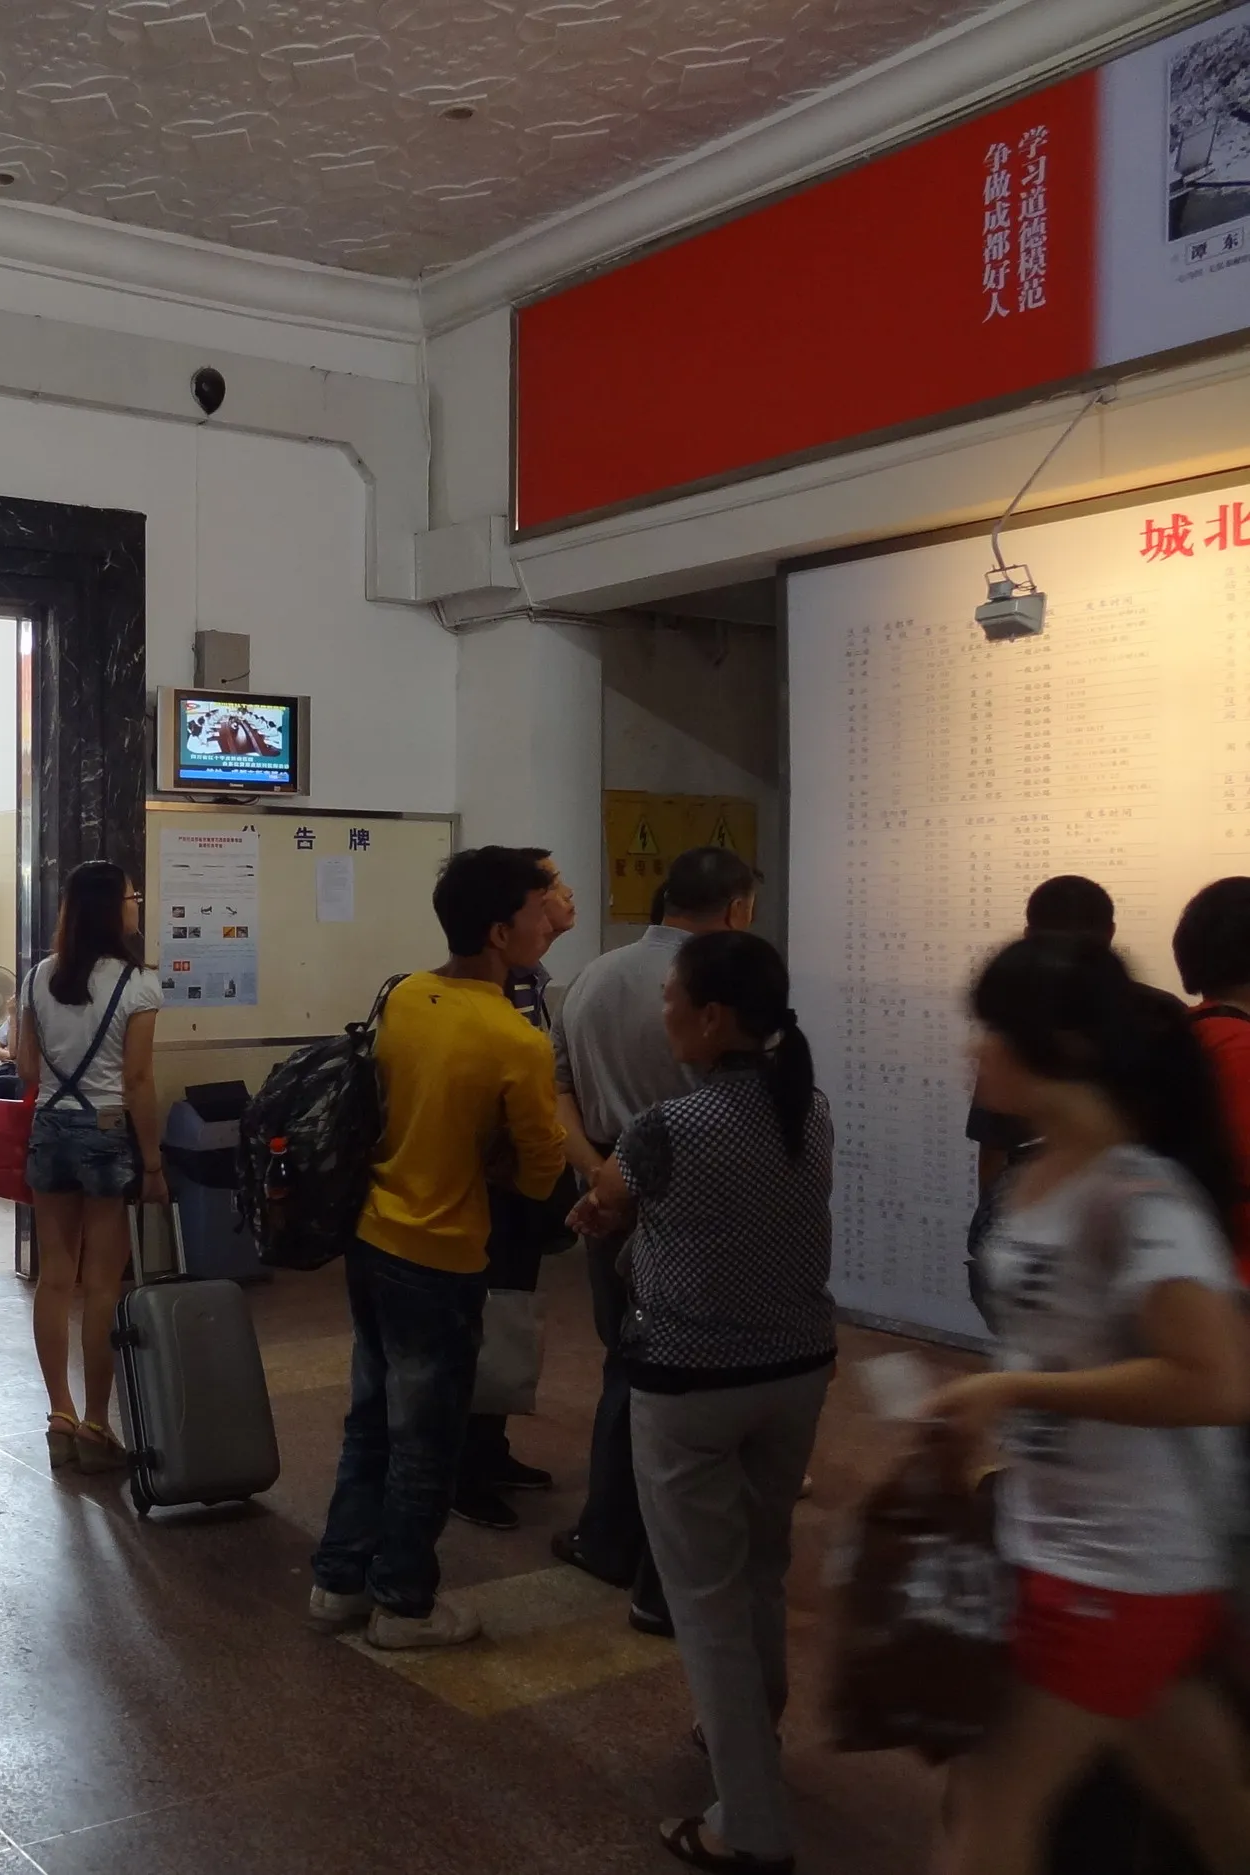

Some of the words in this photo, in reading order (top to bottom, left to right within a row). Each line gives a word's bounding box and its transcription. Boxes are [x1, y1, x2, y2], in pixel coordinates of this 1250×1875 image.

[982, 142, 1013, 324] 争做成都好人
[1017, 125, 1049, 313] 学习道德模范
[1139, 502, 1250, 563] 城北
[242, 825, 371, 851] 告牌
